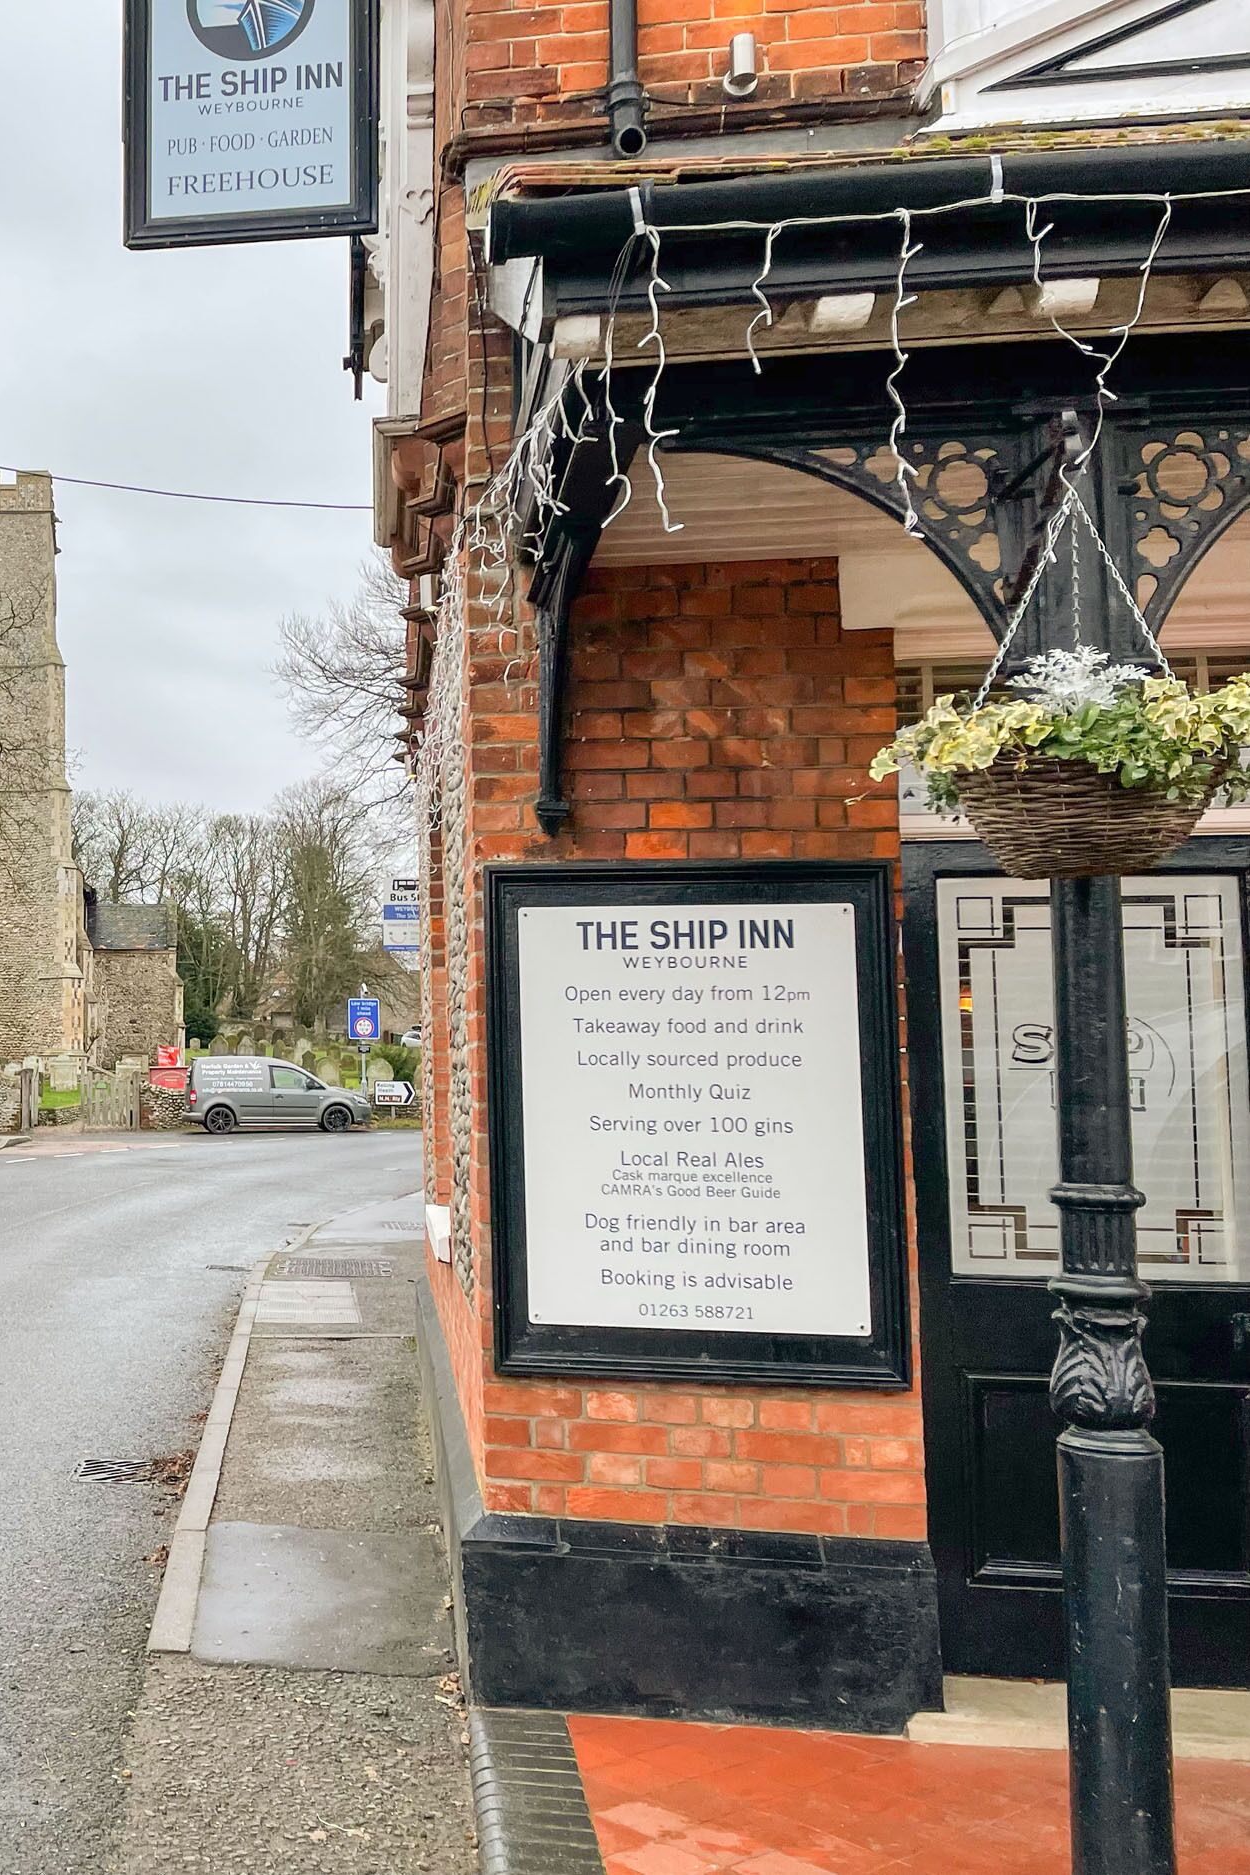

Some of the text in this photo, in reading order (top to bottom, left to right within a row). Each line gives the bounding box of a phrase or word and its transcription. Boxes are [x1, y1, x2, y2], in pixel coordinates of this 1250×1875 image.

[158, 61, 343, 101] THE SHIP INN
[198, 97, 304, 115] WEYBOURNE
[167, 126, 333, 155] PUB FOOD GARDEN
[167, 164, 334, 196] FREEHOUSE
[390, 893, 408, 902] Bus
[576, 919, 794, 950] THE SHIP INN
[623, 956, 747, 968] WEYBOURNE
[565, 985, 810, 1004] Open every day from 12pm
[573, 1018, 803, 1037] Takeaway food and drink
[578, 1051, 802, 1069] Locally sourced produce
[629, 1083, 750, 1102] Monthly Quiz
[590, 1116, 793, 1136] Serving over 100 gins
[621, 1151, 764, 1168] Local Real Ales
[613, 1169, 772, 1184] Cask marque excellence
[602, 1184, 780, 1198] CAMRA's Good Beer Guide
[586, 1214, 805, 1235] Dog friendly in bar area
[600, 1237, 790, 1258] and bar dining room
[601, 1269, 792, 1290] Booking is advisable
[639, 1304, 753, 1319] 01263 588721
